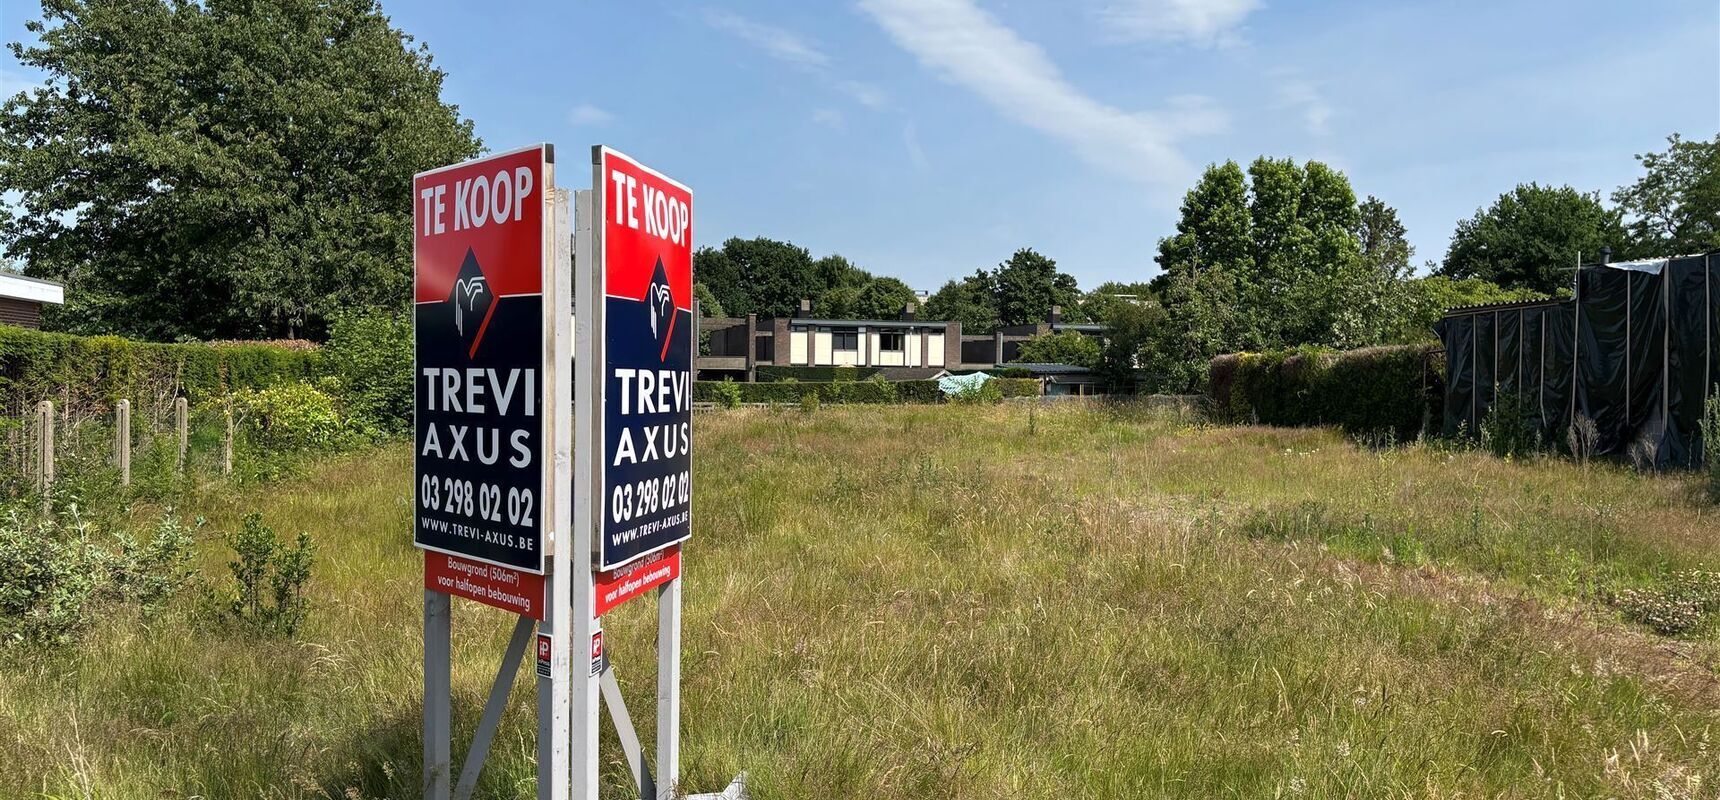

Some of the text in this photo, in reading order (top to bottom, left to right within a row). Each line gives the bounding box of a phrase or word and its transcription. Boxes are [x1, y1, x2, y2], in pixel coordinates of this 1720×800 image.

[421, 166, 533, 237] TE KOOP
[612, 169, 689, 247] TE KOOP
[423, 367, 535, 416] TREVI
[615, 368, 689, 415] TREVI
[422, 422, 532, 468] AXUS
[613, 422, 689, 466] AXUS
[421, 473, 533, 527] 03 298 02 02
[612, 470, 689, 524] 03 298 02 02
[421, 517, 534, 551] WWW.TREVI-AXUS.BE
[612, 510, 689, 547] WWW.TREVI-AXUS.BE
[447, 557, 488, 578] Bouwgrond
[605, 565, 671, 604] voor halfopen bebouwing
[437, 575, 531, 612] voor halfopen bebouwing
